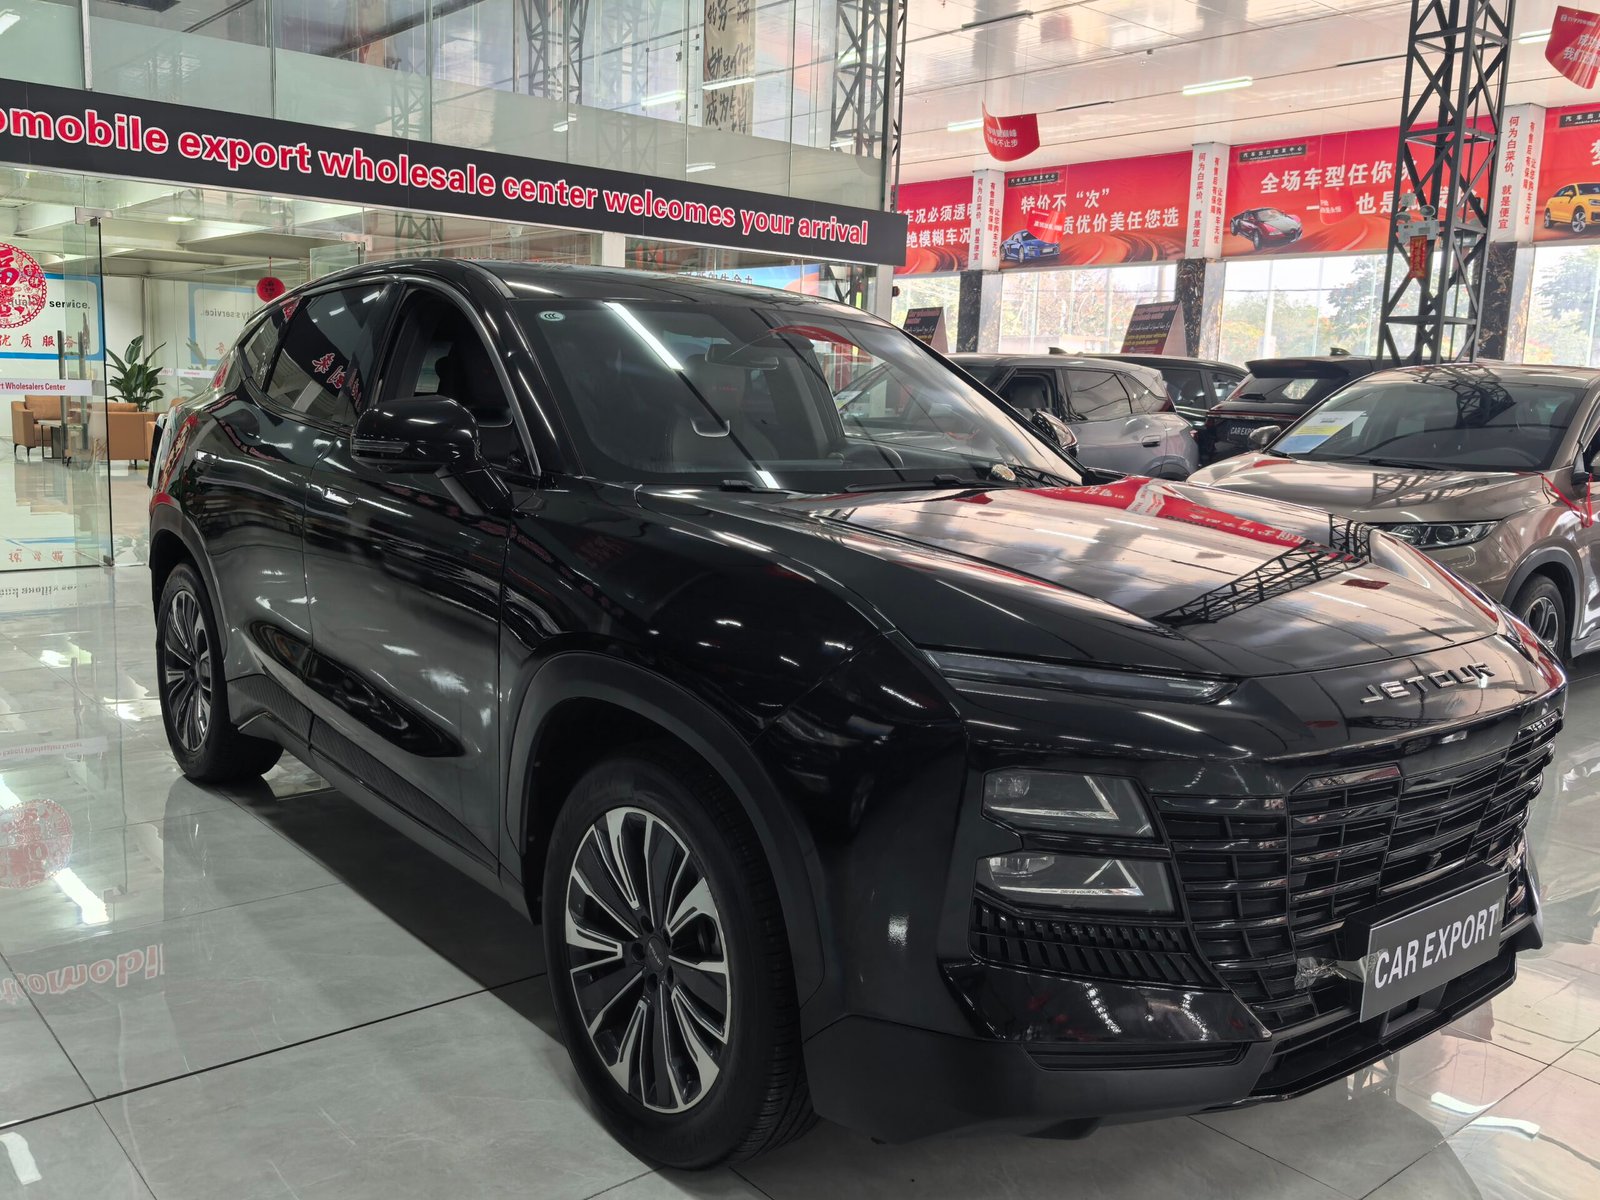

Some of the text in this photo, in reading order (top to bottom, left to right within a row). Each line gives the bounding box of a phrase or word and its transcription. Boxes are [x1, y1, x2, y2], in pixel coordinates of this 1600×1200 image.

[0, 107, 869, 246] mobile export wholesale center welcomes your arrival
[5, 382, 45, 391] Wholesalers
[45, 382, 66, 391] Center
[1360, 661, 1496, 704] JETOUR
[1374, 902, 1500, 989] CAR EXPORT
